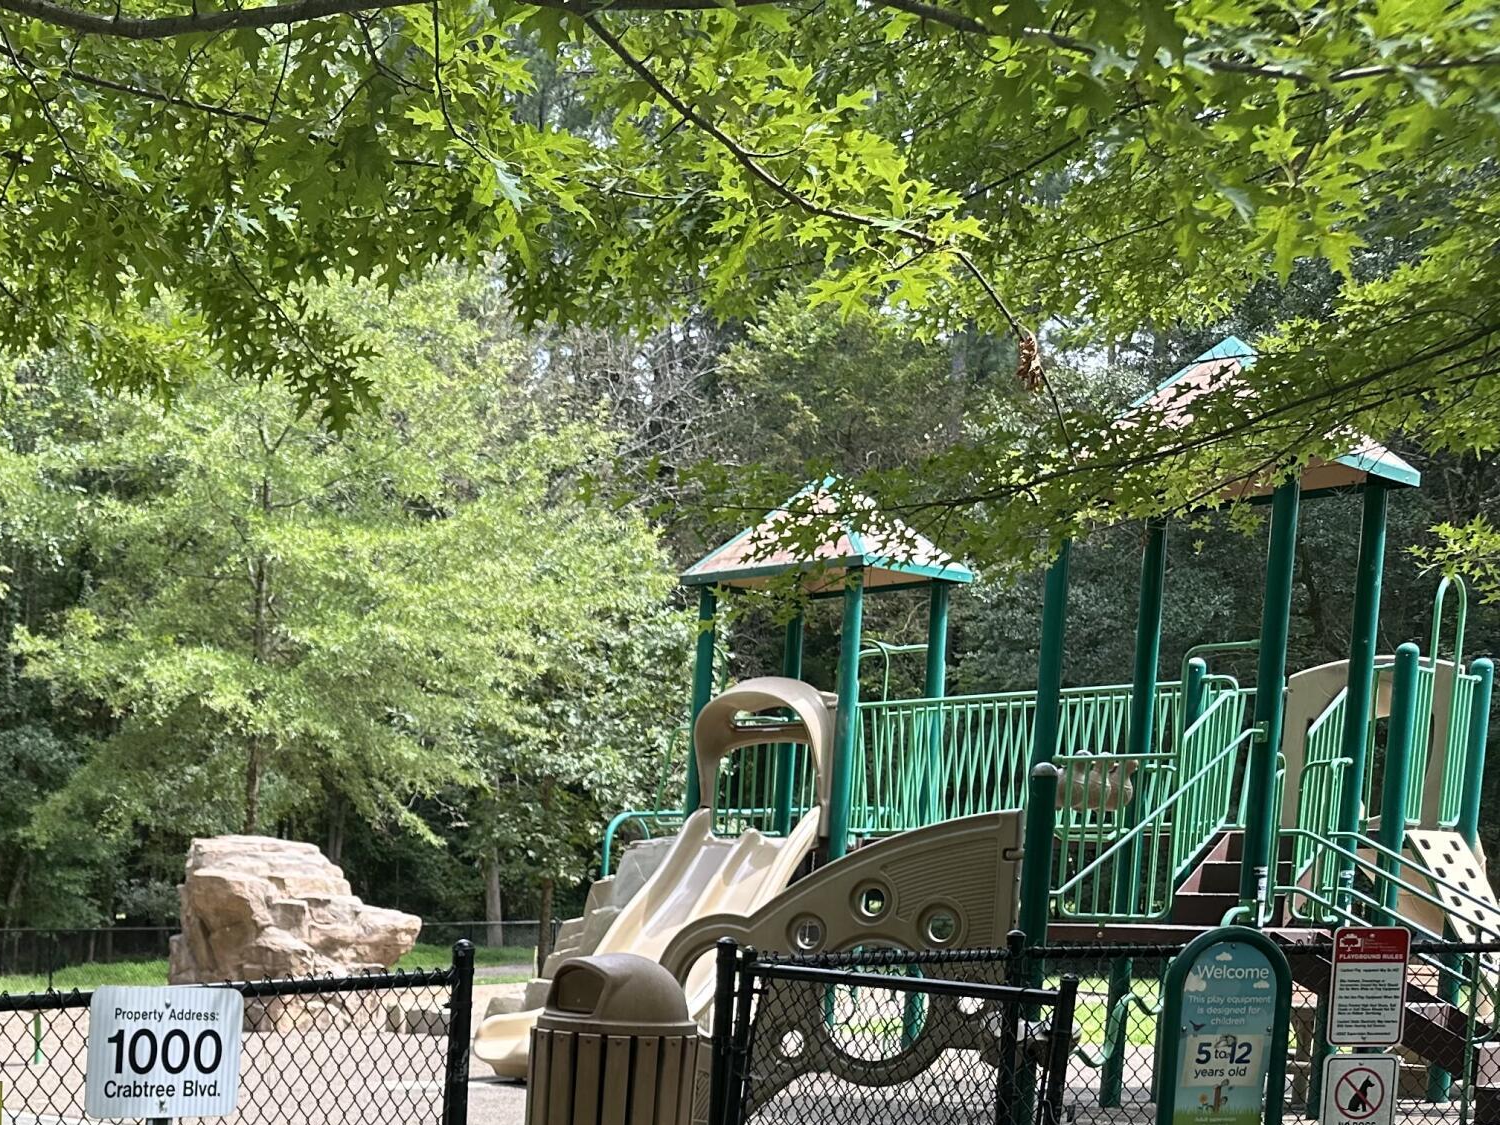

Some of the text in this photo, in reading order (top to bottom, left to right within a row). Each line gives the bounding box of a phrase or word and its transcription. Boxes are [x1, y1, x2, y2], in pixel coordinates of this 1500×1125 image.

[1197, 964, 1270, 979] Welcome
[1188, 995, 1271, 1005] This play equipment
[114, 1007, 220, 1022] Property Address:
[1197, 1006, 1261, 1016] is designed for
[1210, 1017, 1245, 1025] children
[107, 1028, 223, 1075] 1000
[1195, 1041, 1253, 1065] 5 to 12
[1194, 1066, 1247, 1079] years old
[104, 1080, 221, 1099] Crabtree Blvd.
